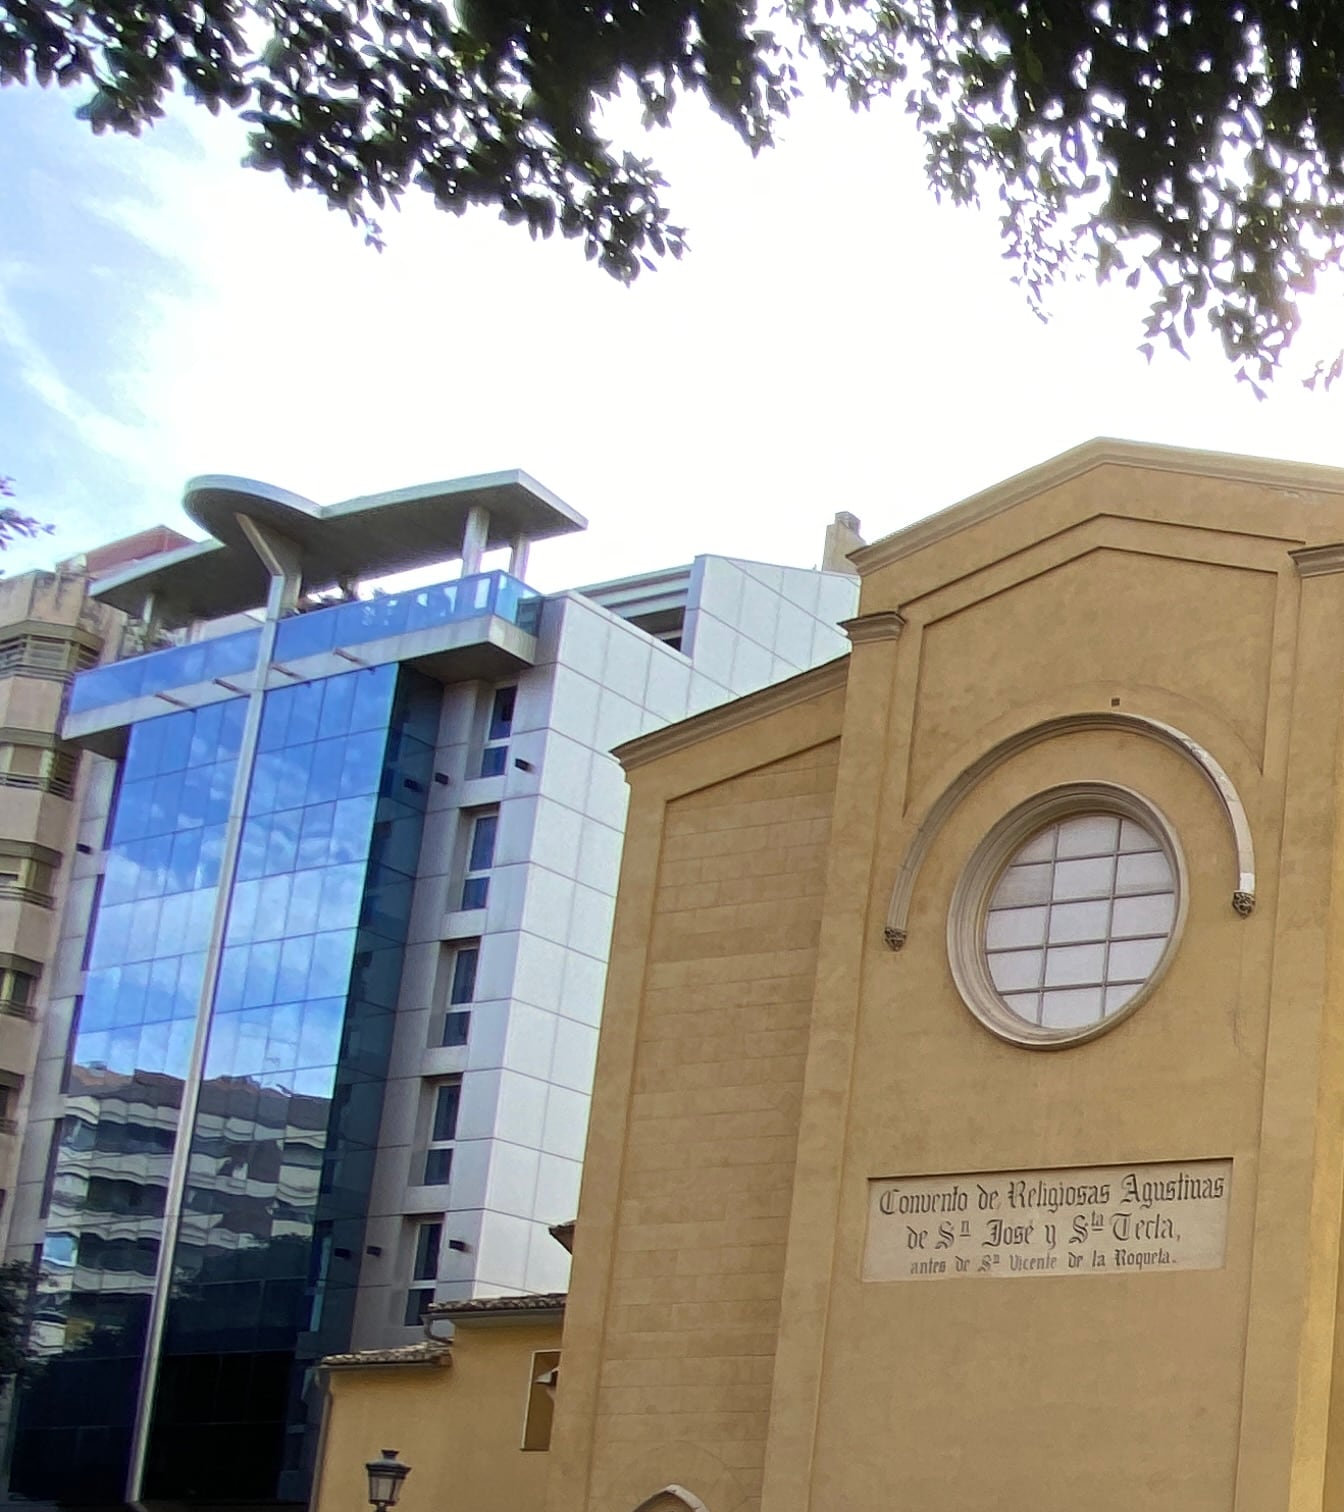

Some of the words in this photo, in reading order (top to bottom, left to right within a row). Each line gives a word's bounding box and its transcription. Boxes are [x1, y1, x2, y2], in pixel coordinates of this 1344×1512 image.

[880, 1186, 968, 1215] Convento
[976, 1184, 999, 1210] de
[1008, 1180, 1110, 1213] Religiosas
[1120, 1172, 1224, 1209] Agustinas
[906, 1225, 929, 1250] de
[981, 1219, 1034, 1247] José
[1044, 1224, 1056, 1250] y
[910, 1257, 946, 1275] antes
[955, 1255, 970, 1272] de
[1009, 1252, 1057, 1271] Vicente
[1068, 1252, 1083, 1268] de
[1092, 1250, 1106, 1267] la
